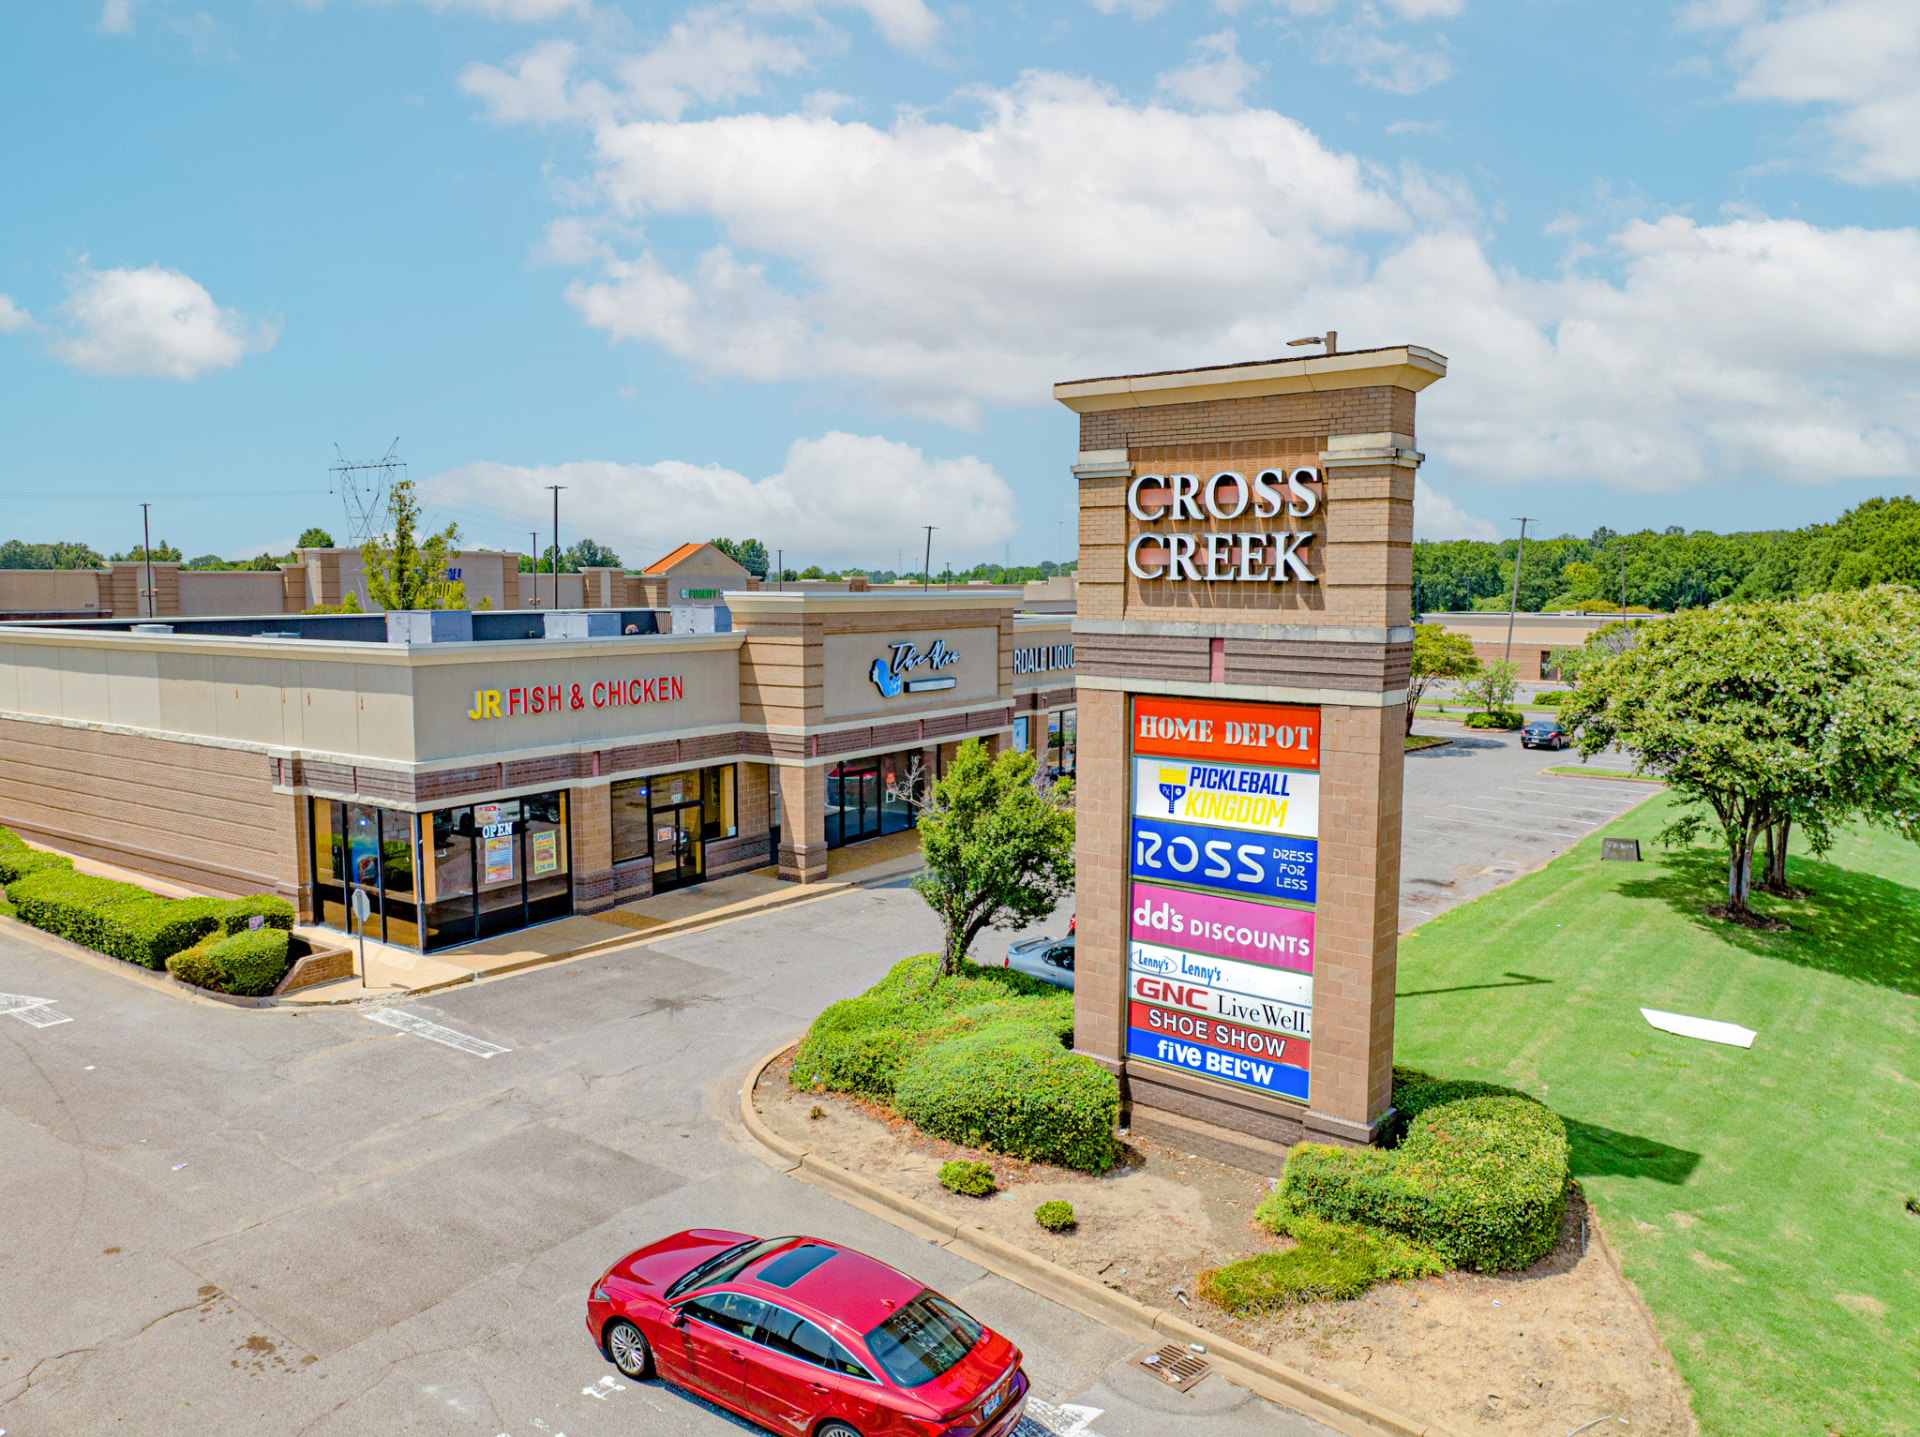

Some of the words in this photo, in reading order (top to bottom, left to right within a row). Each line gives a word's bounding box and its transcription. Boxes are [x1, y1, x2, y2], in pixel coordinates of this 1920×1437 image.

[1127, 466, 1318, 521] CROSS
[1127, 532, 1315, 581] CREEK
[889, 643, 928, 673] The
[467, 690, 502, 720] JR
[506, 685, 562, 716] FISH
[569, 683, 585, 711] &
[590, 675, 683, 709] CHICKEN
[1139, 715, 1213, 743] HOME
[1224, 721, 1313, 750] DEPOT
[1189, 766, 1290, 797] PICKLEBALL
[1184, 790, 1288, 828] KINGDOM
[482, 822, 513, 839] OPEN
[1137, 830, 1266, 884] ROSS
[1273, 848, 1313, 864] DRESS
[1279, 863, 1305, 877] FOR
[1276, 876, 1308, 891] LESS
[1133, 900, 1184, 933] dd's
[1190, 919, 1310, 957] DISCOUNTS
[1139, 949, 1169, 974] Lenny's
[1182, 954, 1221, 985] Lenny's
[1136, 977, 1208, 1011] GNC
[1148, 1008, 1209, 1040] SHOE
[1215, 1025, 1286, 1058] SHOW
